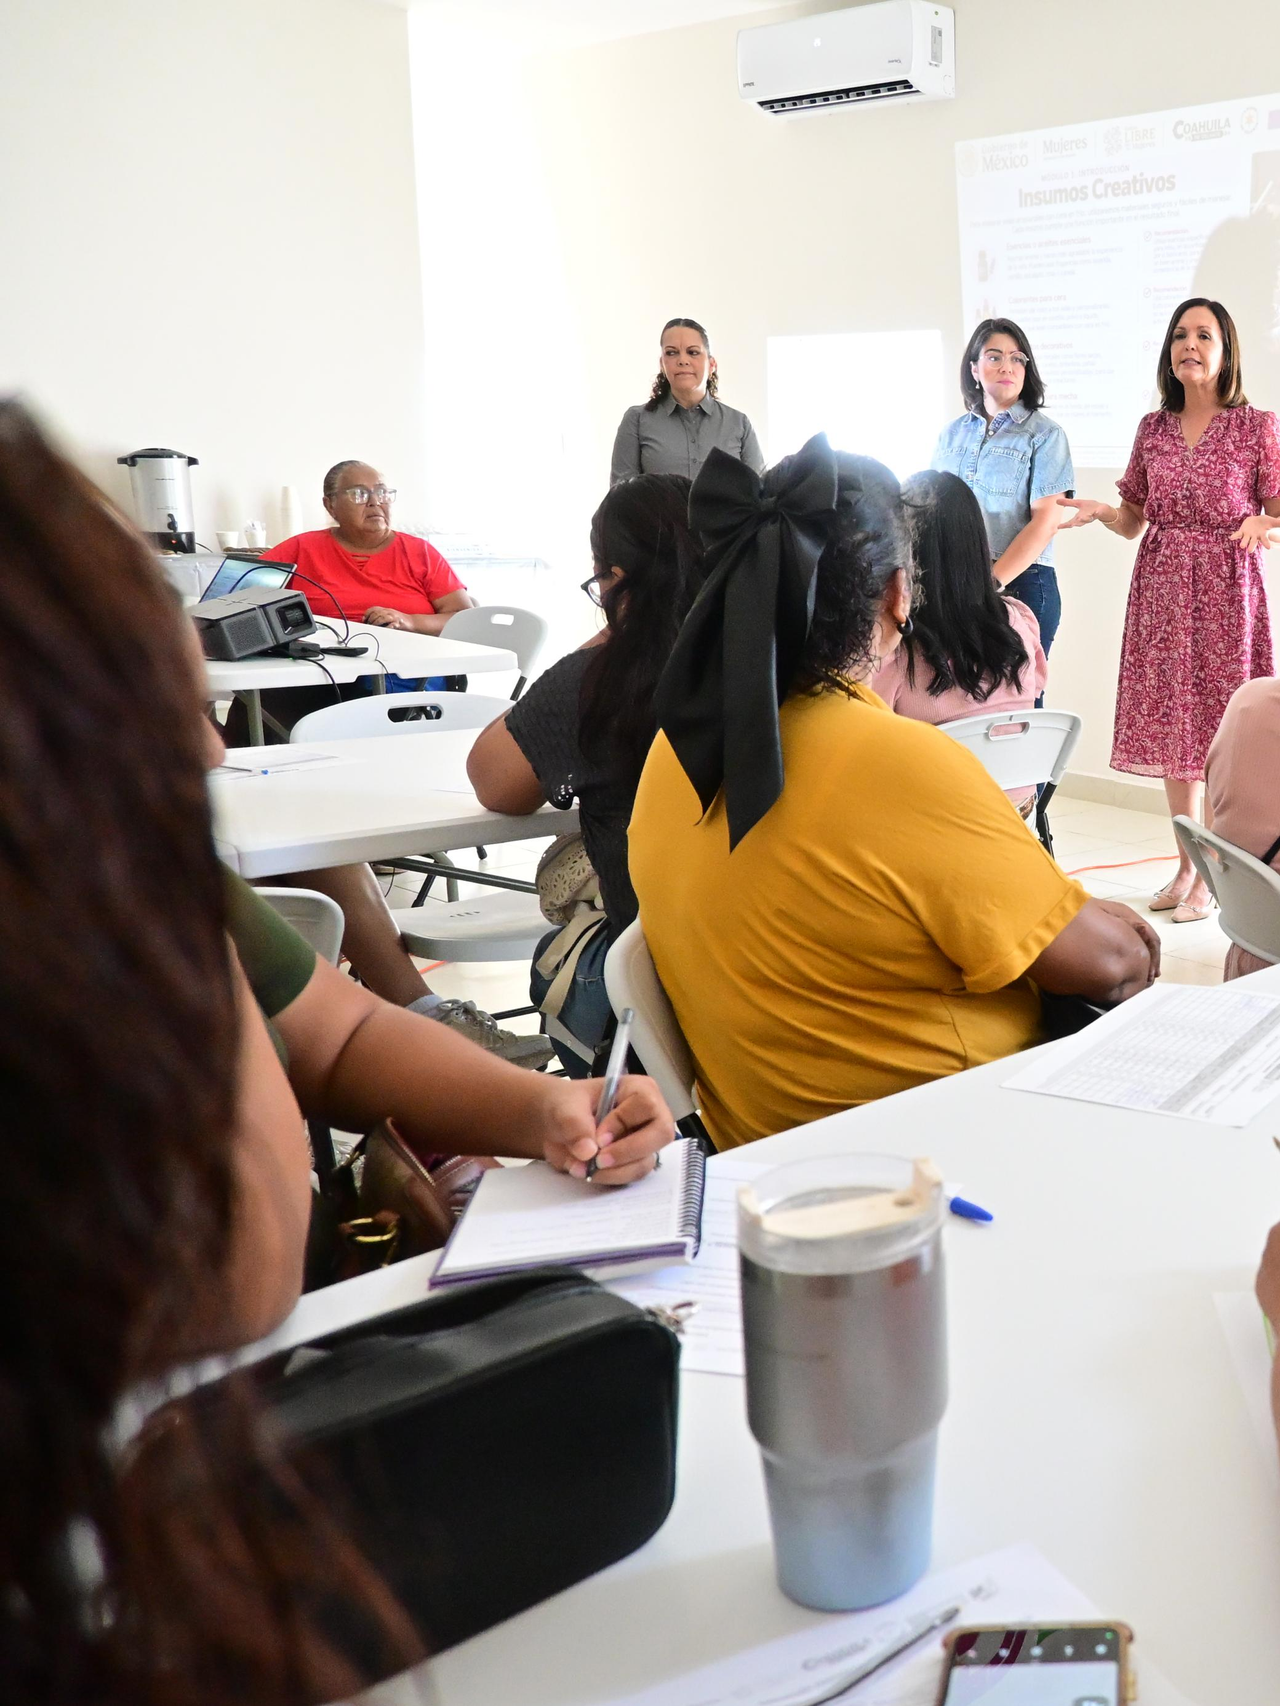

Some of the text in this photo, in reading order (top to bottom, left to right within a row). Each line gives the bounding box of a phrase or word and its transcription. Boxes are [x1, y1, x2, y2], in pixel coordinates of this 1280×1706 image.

[1124, 127, 1156, 143] LIBRE
[1172, 118, 1231, 139] COAHUILA
[981, 139, 1029, 154] Gobierno de
[1042, 137, 1088, 154] Mujeres
[982, 153, 1029, 173] México
[1018, 171, 1177, 208] Insumos Creativos
[1059, 235, 1092, 246] esenciales
